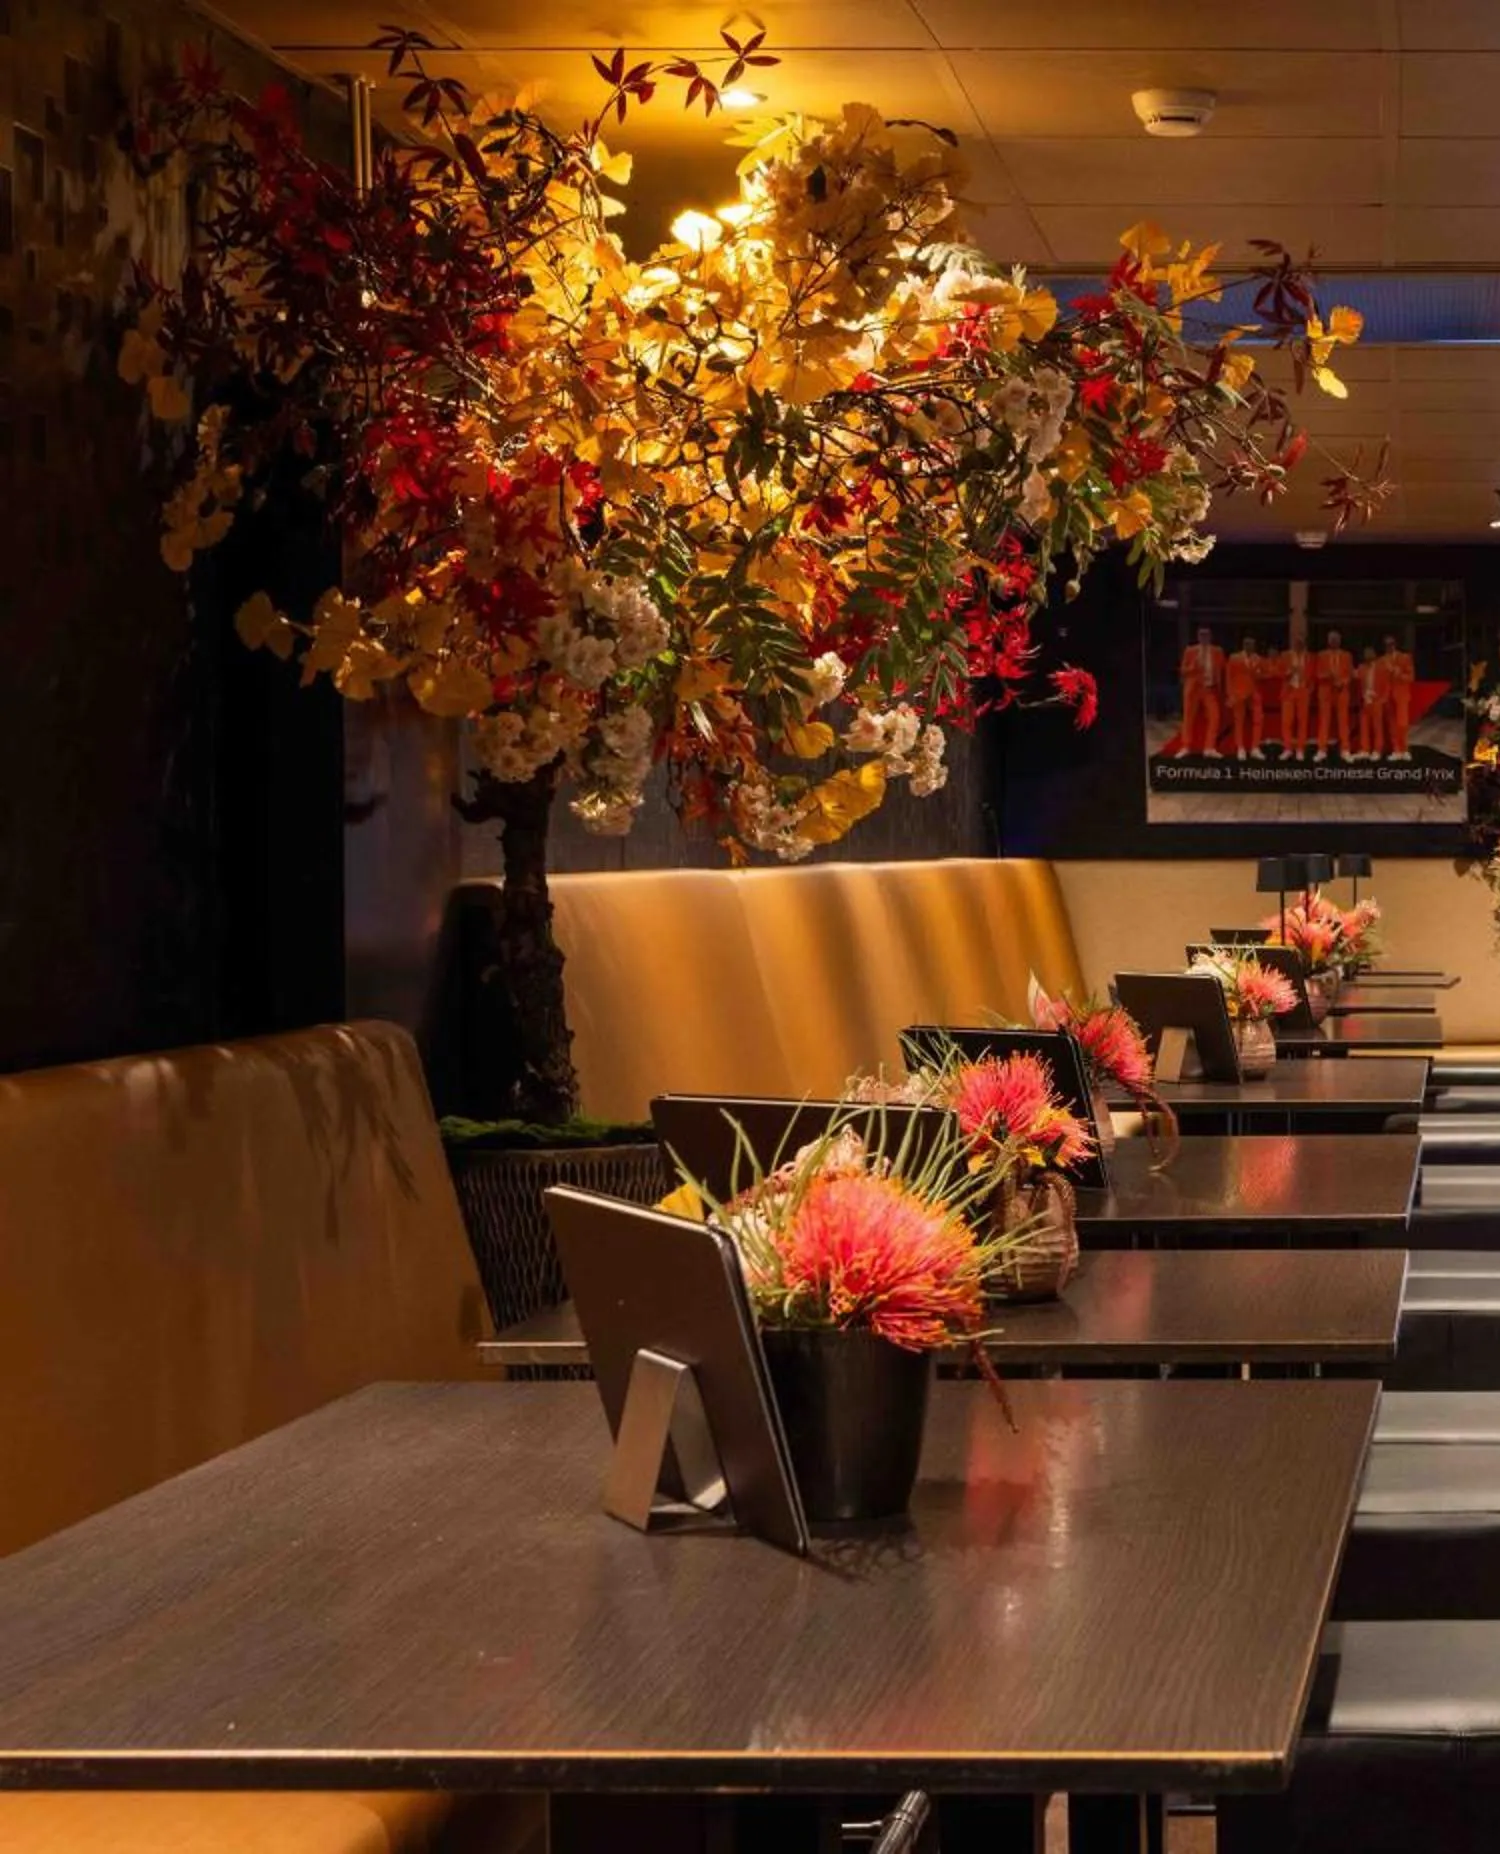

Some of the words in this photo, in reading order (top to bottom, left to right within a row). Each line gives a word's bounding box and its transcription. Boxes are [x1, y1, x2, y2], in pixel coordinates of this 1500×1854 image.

[1155, 765, 1222, 780] Formula
[1224, 766, 1233, 780] 1
[1239, 766, 1313, 781] Heineken
[1314, 766, 1375, 781] Chinese
[1376, 766, 1423, 781] Grand
